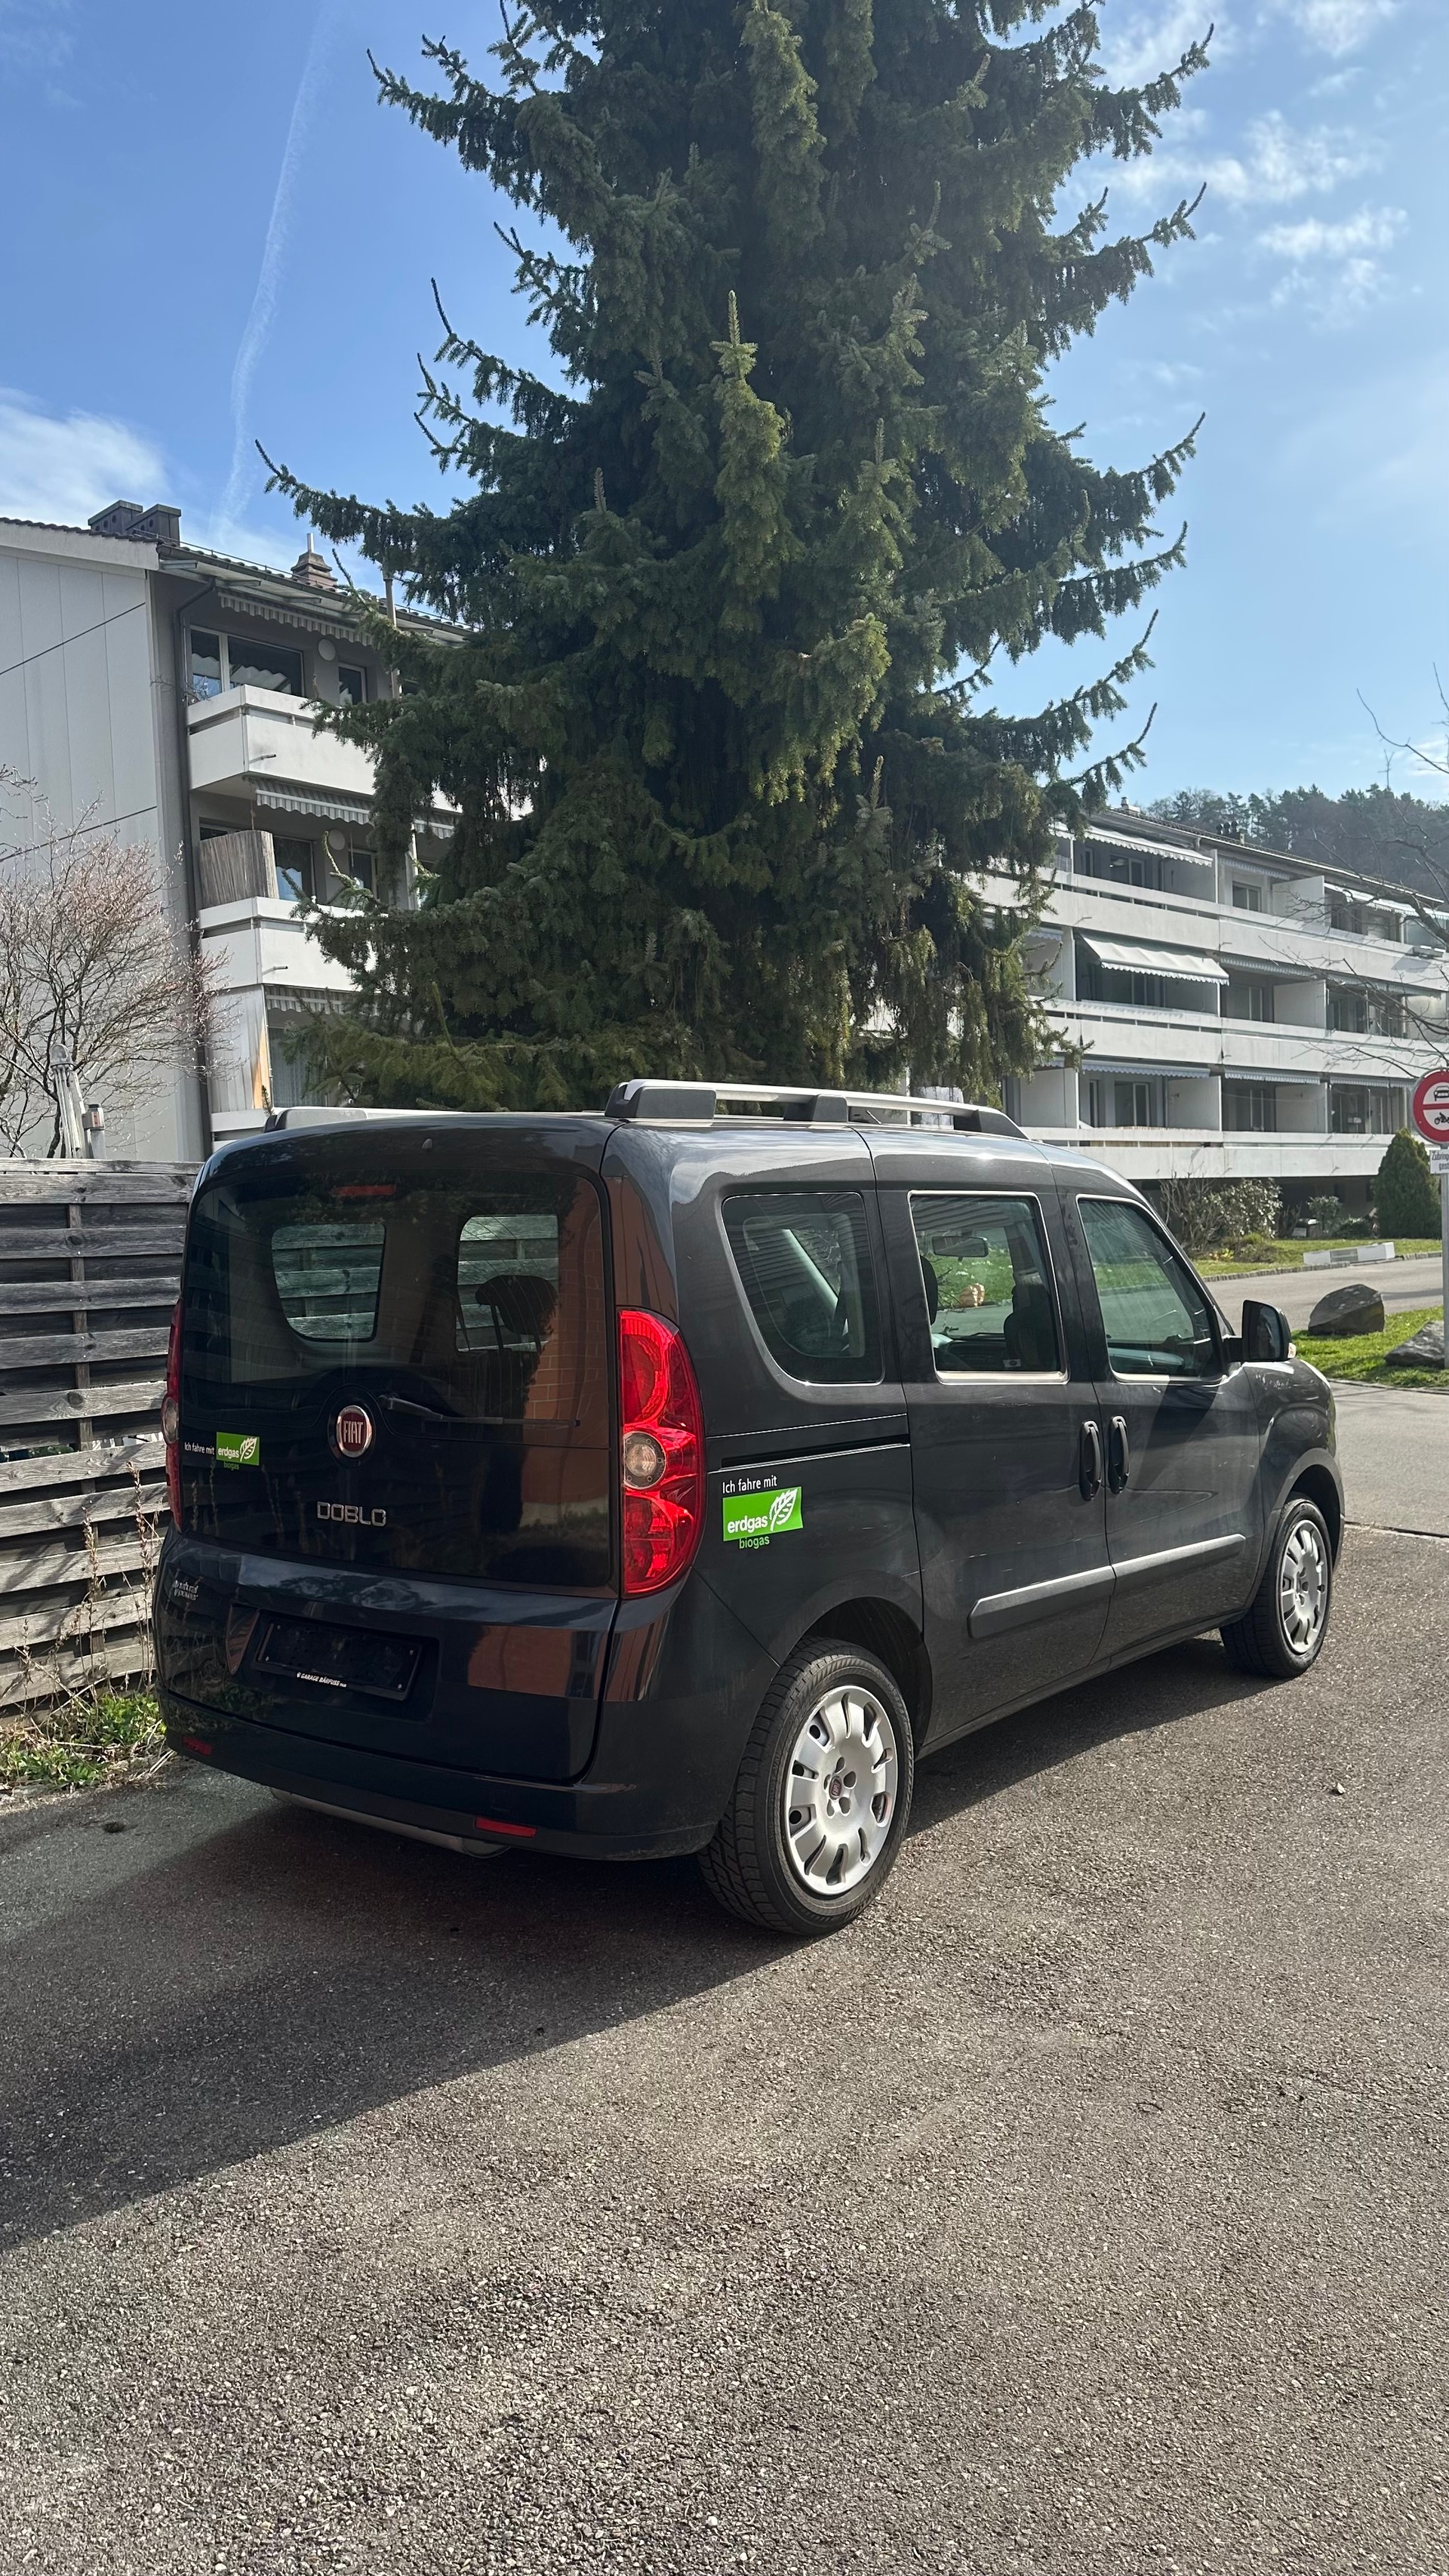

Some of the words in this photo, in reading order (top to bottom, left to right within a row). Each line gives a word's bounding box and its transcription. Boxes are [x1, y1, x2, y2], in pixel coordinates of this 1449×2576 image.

[343, 1420, 364, 1444] FIAT
[192, 1442, 205, 1454] fahre
[205, 1445, 215, 1455] mit
[217, 1446, 240, 1459] erdgas
[223, 1460, 240, 1471] biogas
[722, 1480, 736, 1494] Ich
[738, 1478, 761, 1492] fahre
[763, 1474, 777, 1488] mit
[727, 1516, 768, 1534] erdgas
[739, 1536, 771, 1550] biogas
[300, 1673, 320, 1682] GARAGE
